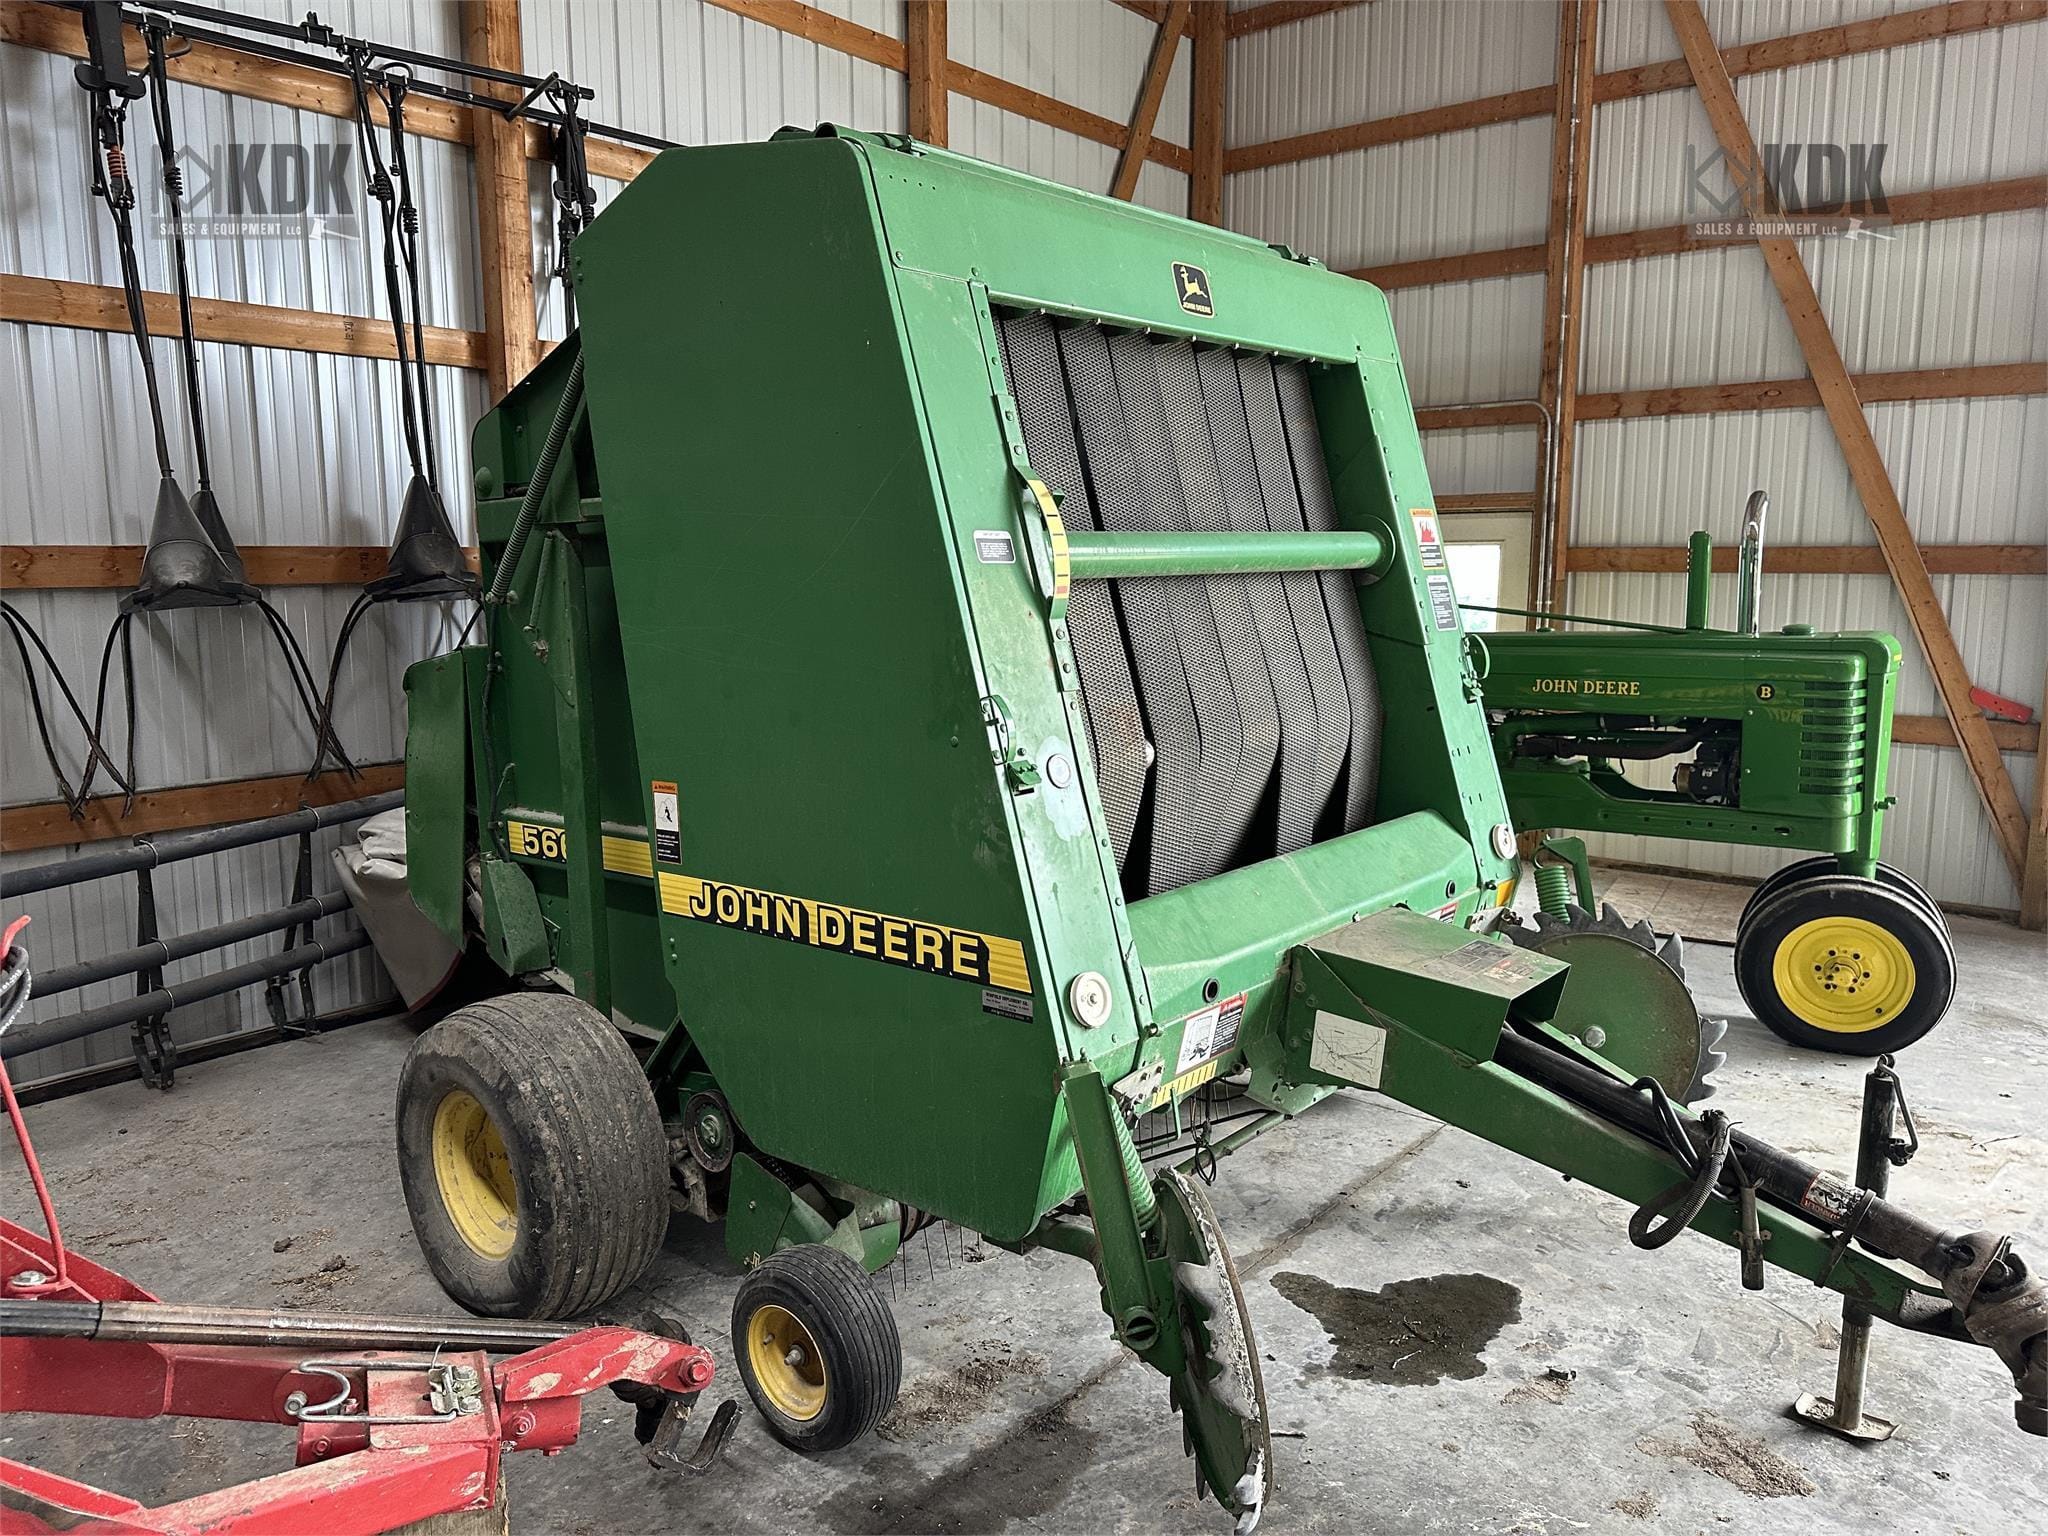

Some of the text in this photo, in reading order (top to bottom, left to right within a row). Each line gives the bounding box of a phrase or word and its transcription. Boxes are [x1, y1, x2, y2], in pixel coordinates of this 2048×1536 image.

[1532, 679, 1640, 696] JOHN DEERE
[1760, 686, 1771, 698] B
[690, 882, 980, 977] JOHN DEERE
